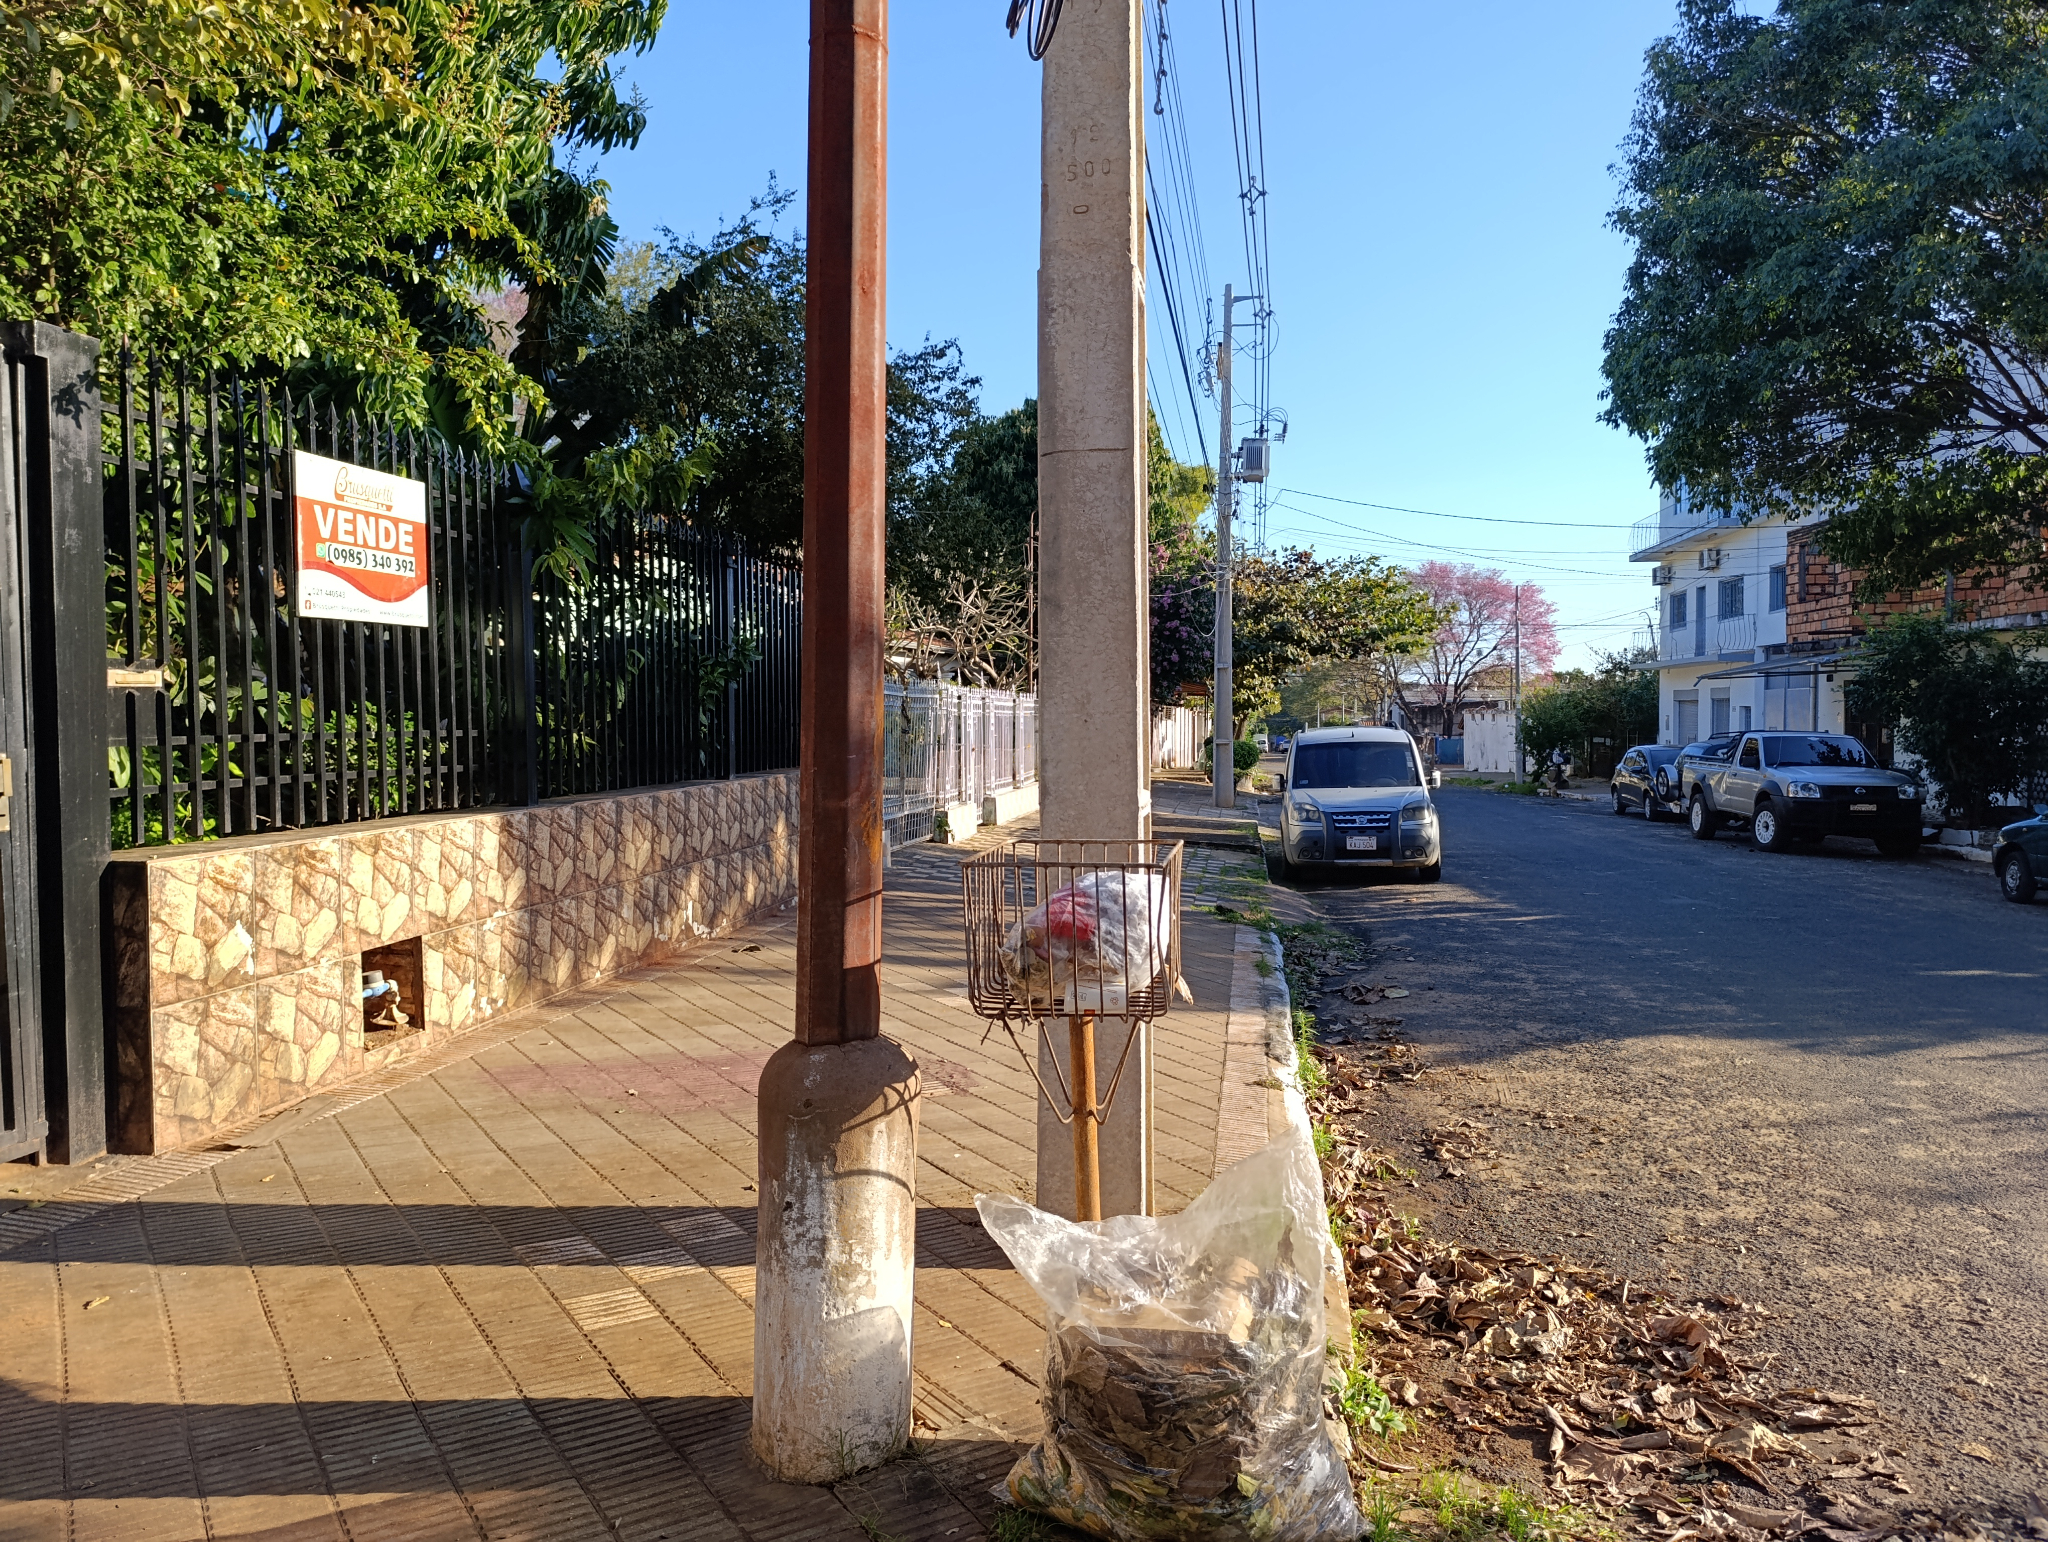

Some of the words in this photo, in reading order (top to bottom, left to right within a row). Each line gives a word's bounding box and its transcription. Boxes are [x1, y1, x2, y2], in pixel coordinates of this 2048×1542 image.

[313, 504, 415, 555] VENDE
[327, 543, 368, 569] (0985)
[371, 553, 392, 570] 340
[394, 557, 415, 574] 392
